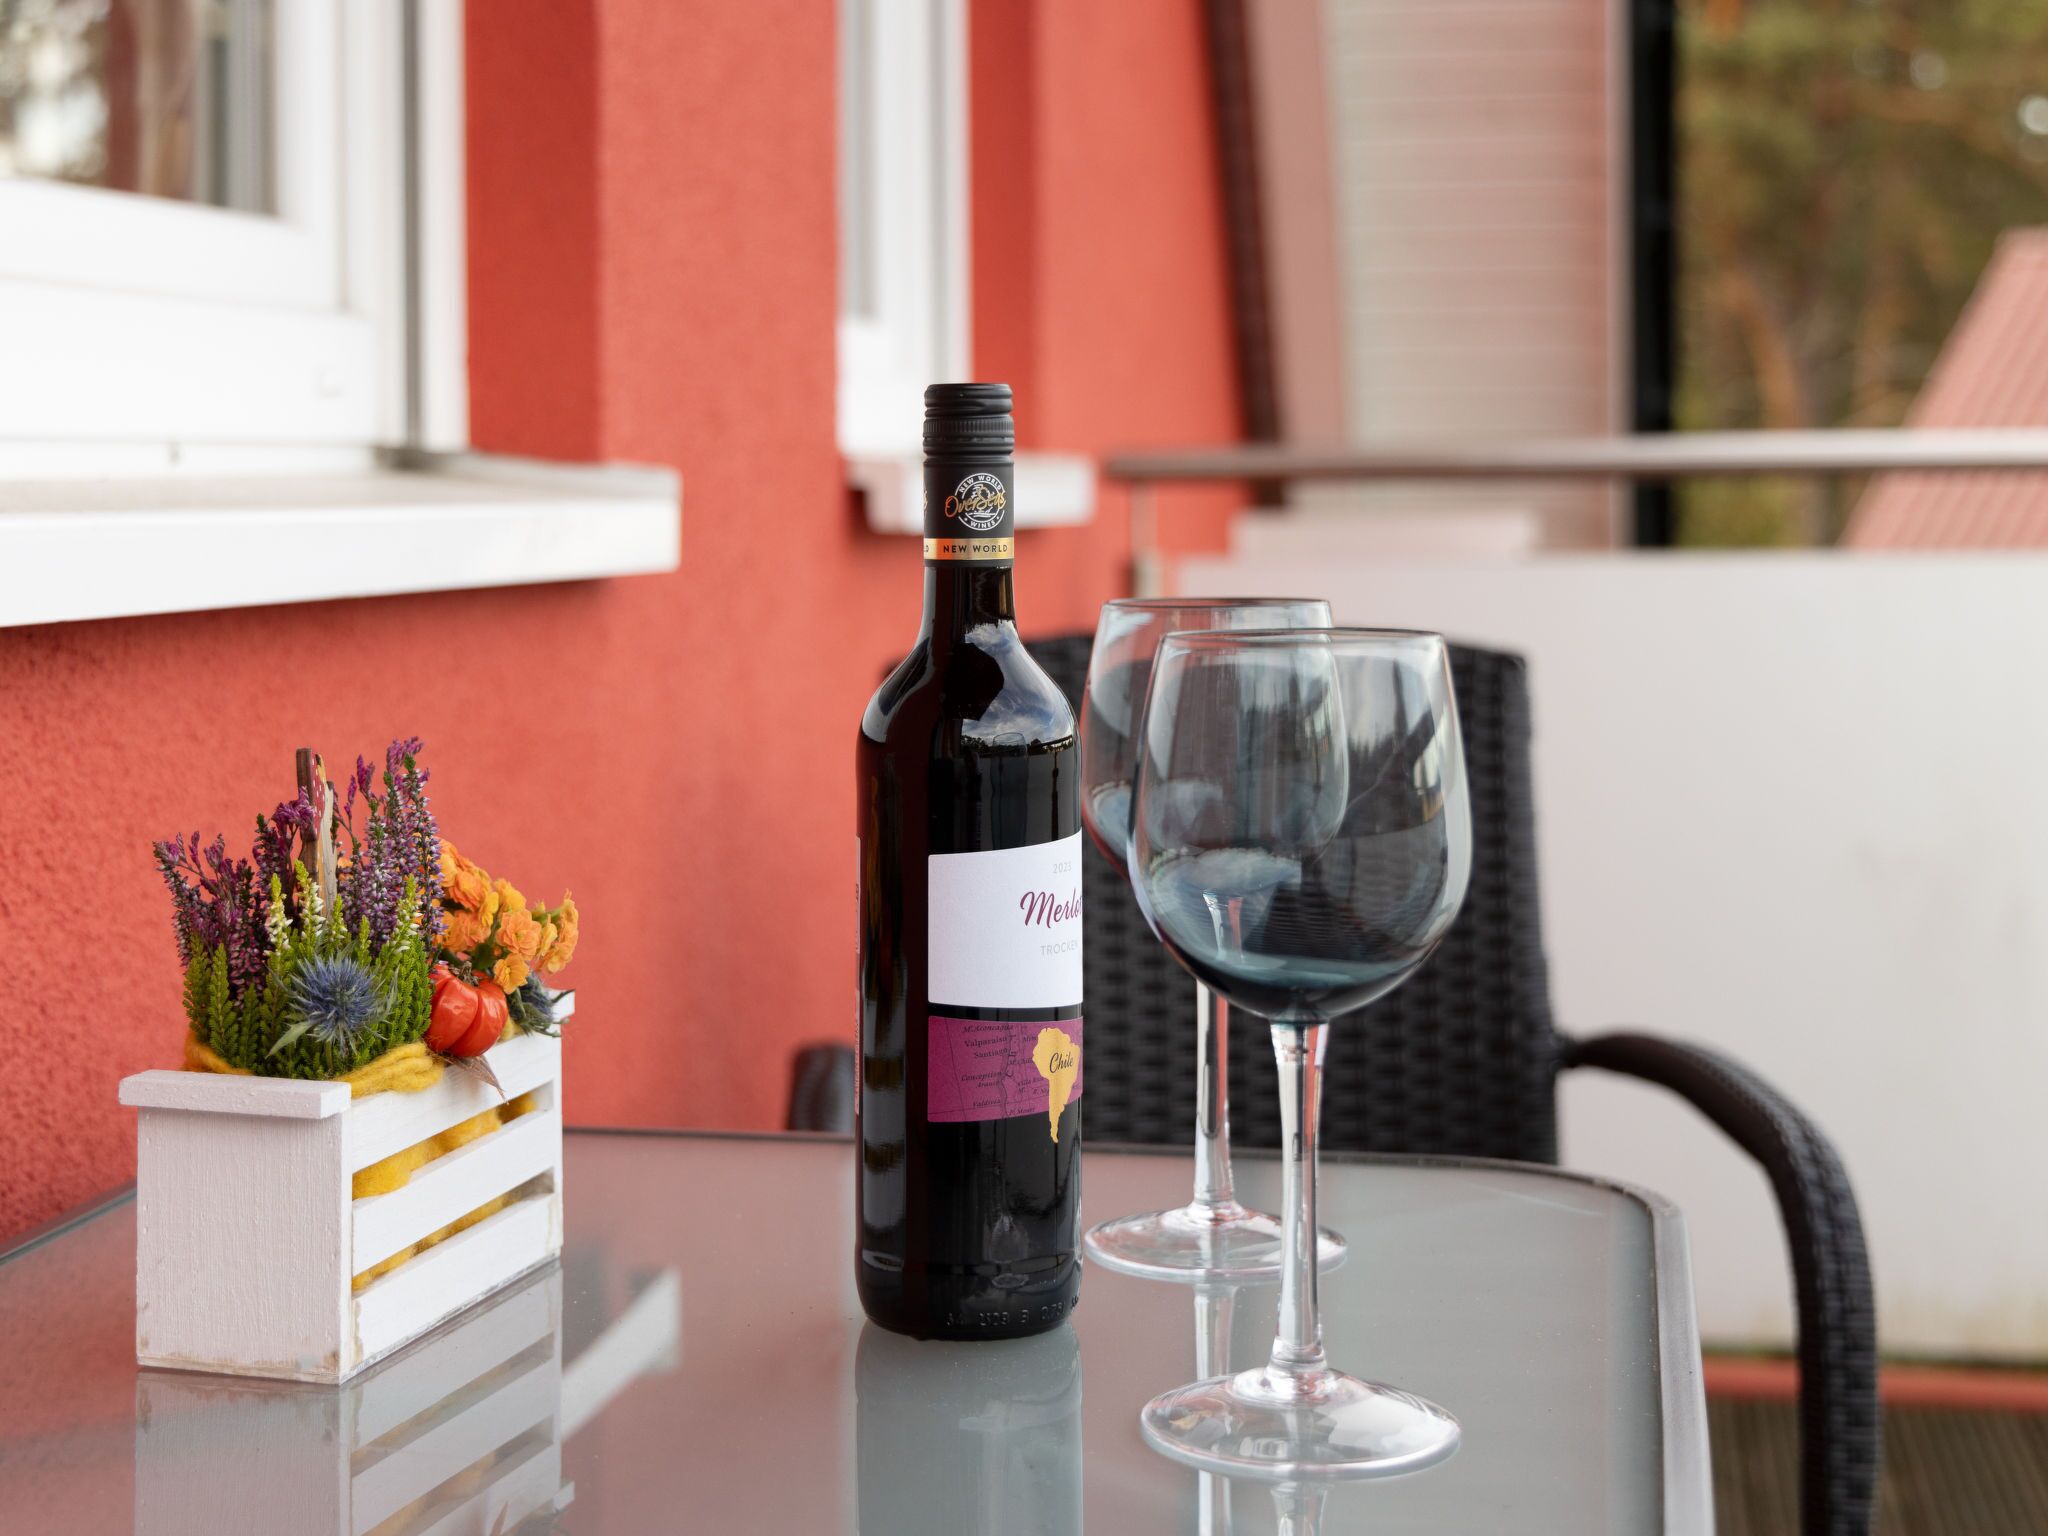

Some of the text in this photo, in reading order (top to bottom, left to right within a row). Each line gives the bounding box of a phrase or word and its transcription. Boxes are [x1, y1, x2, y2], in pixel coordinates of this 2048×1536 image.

[959, 475, 1002, 493] NEW WORLD
[970, 520, 996, 529] WINES
[943, 544, 1008, 553] NEW WORLD
[1050, 1052, 1074, 1073] Chile
